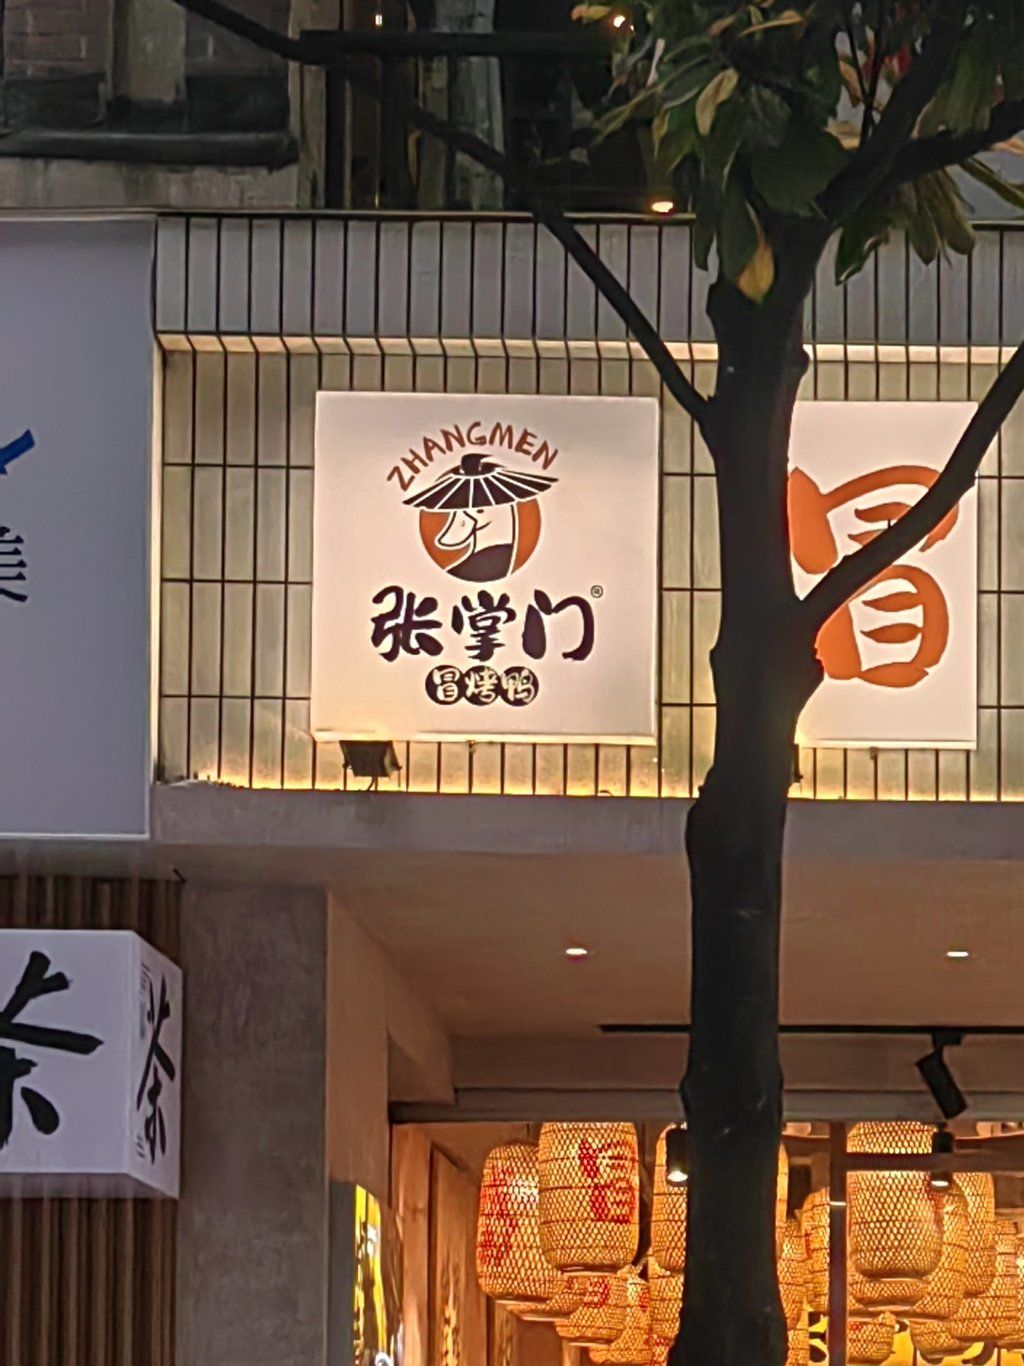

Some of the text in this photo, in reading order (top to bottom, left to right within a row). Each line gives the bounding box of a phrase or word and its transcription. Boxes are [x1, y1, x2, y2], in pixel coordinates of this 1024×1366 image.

[387, 421, 559, 491] ZHANGMEN
[371, 585, 595, 663] 张掌门
[425, 665, 540, 707] 冒烤鸭
